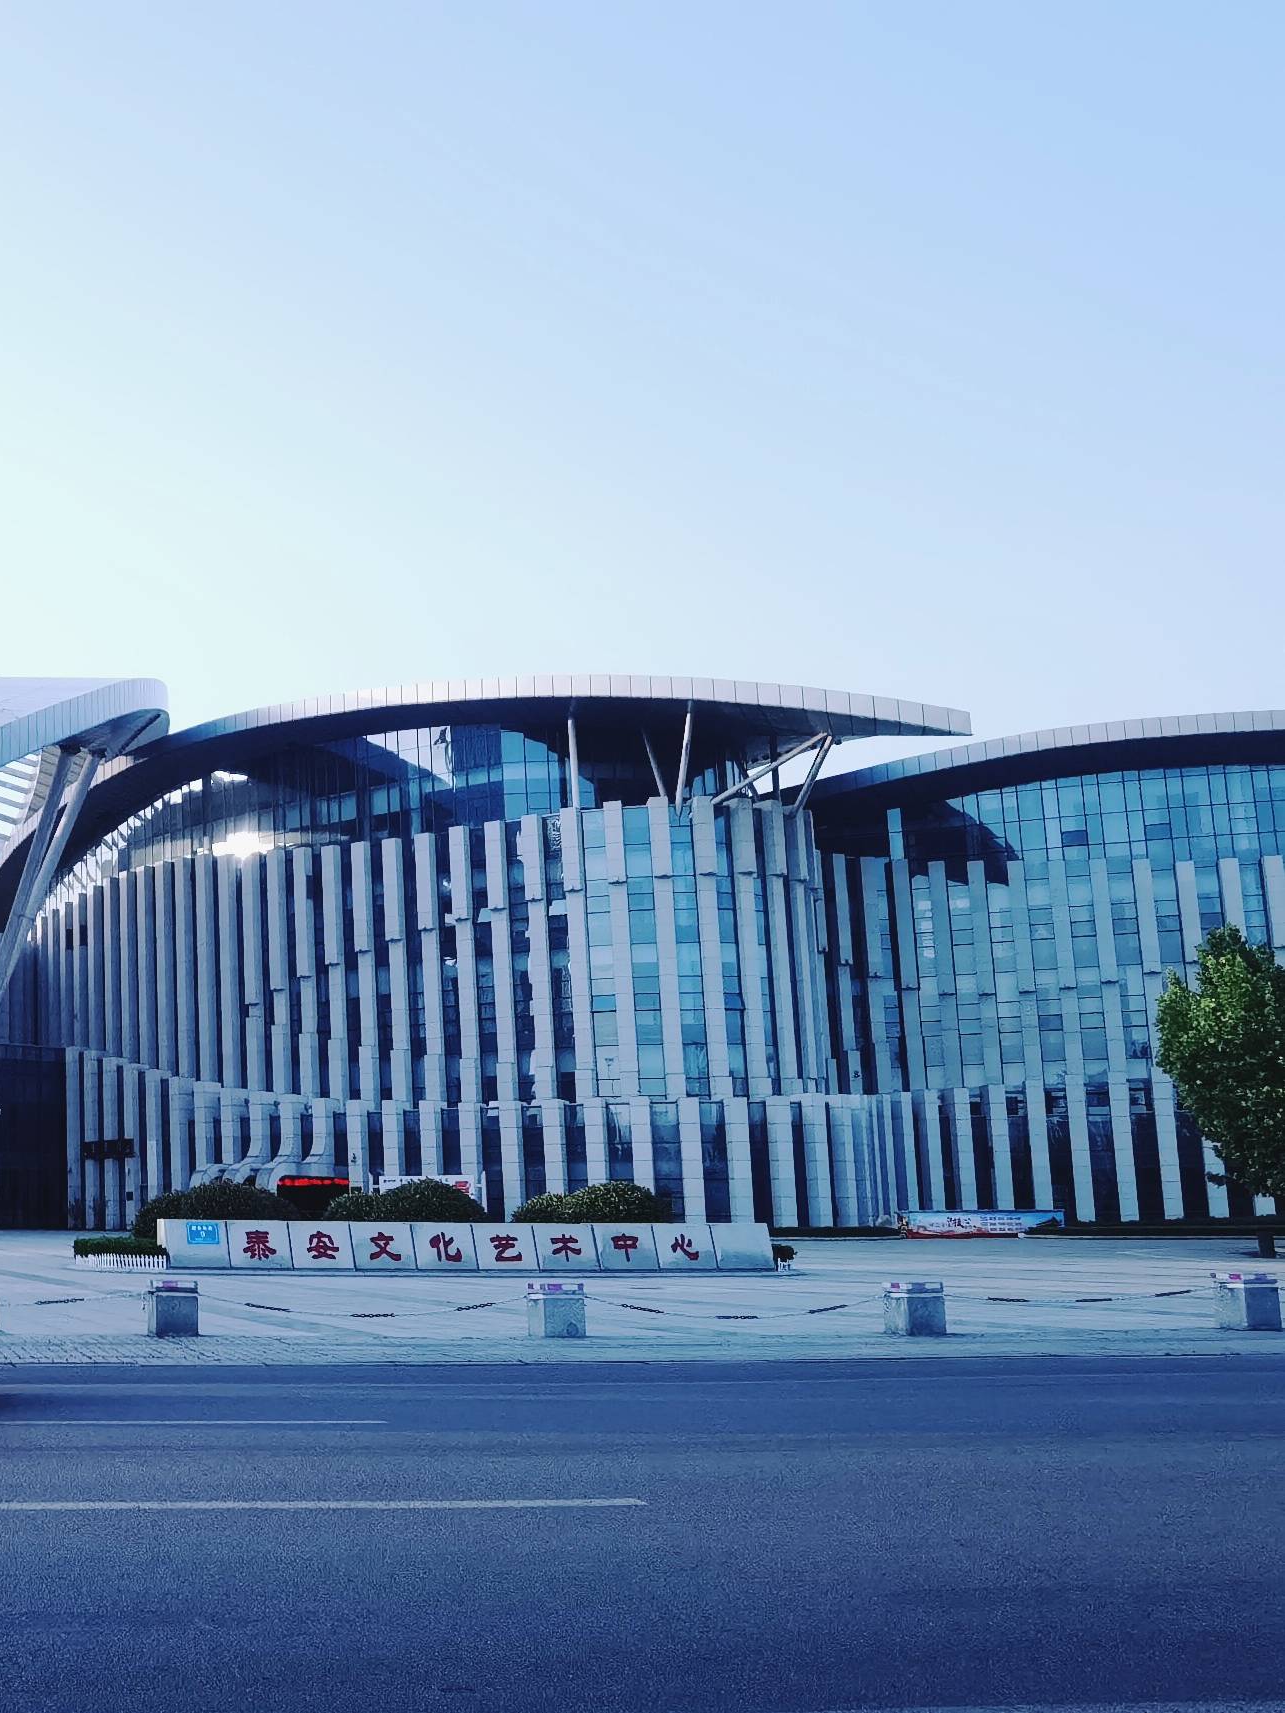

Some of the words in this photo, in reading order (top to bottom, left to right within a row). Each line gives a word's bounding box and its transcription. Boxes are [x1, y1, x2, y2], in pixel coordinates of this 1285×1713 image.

[243, 1230, 700, 1263] 泰安文化艺术中心
